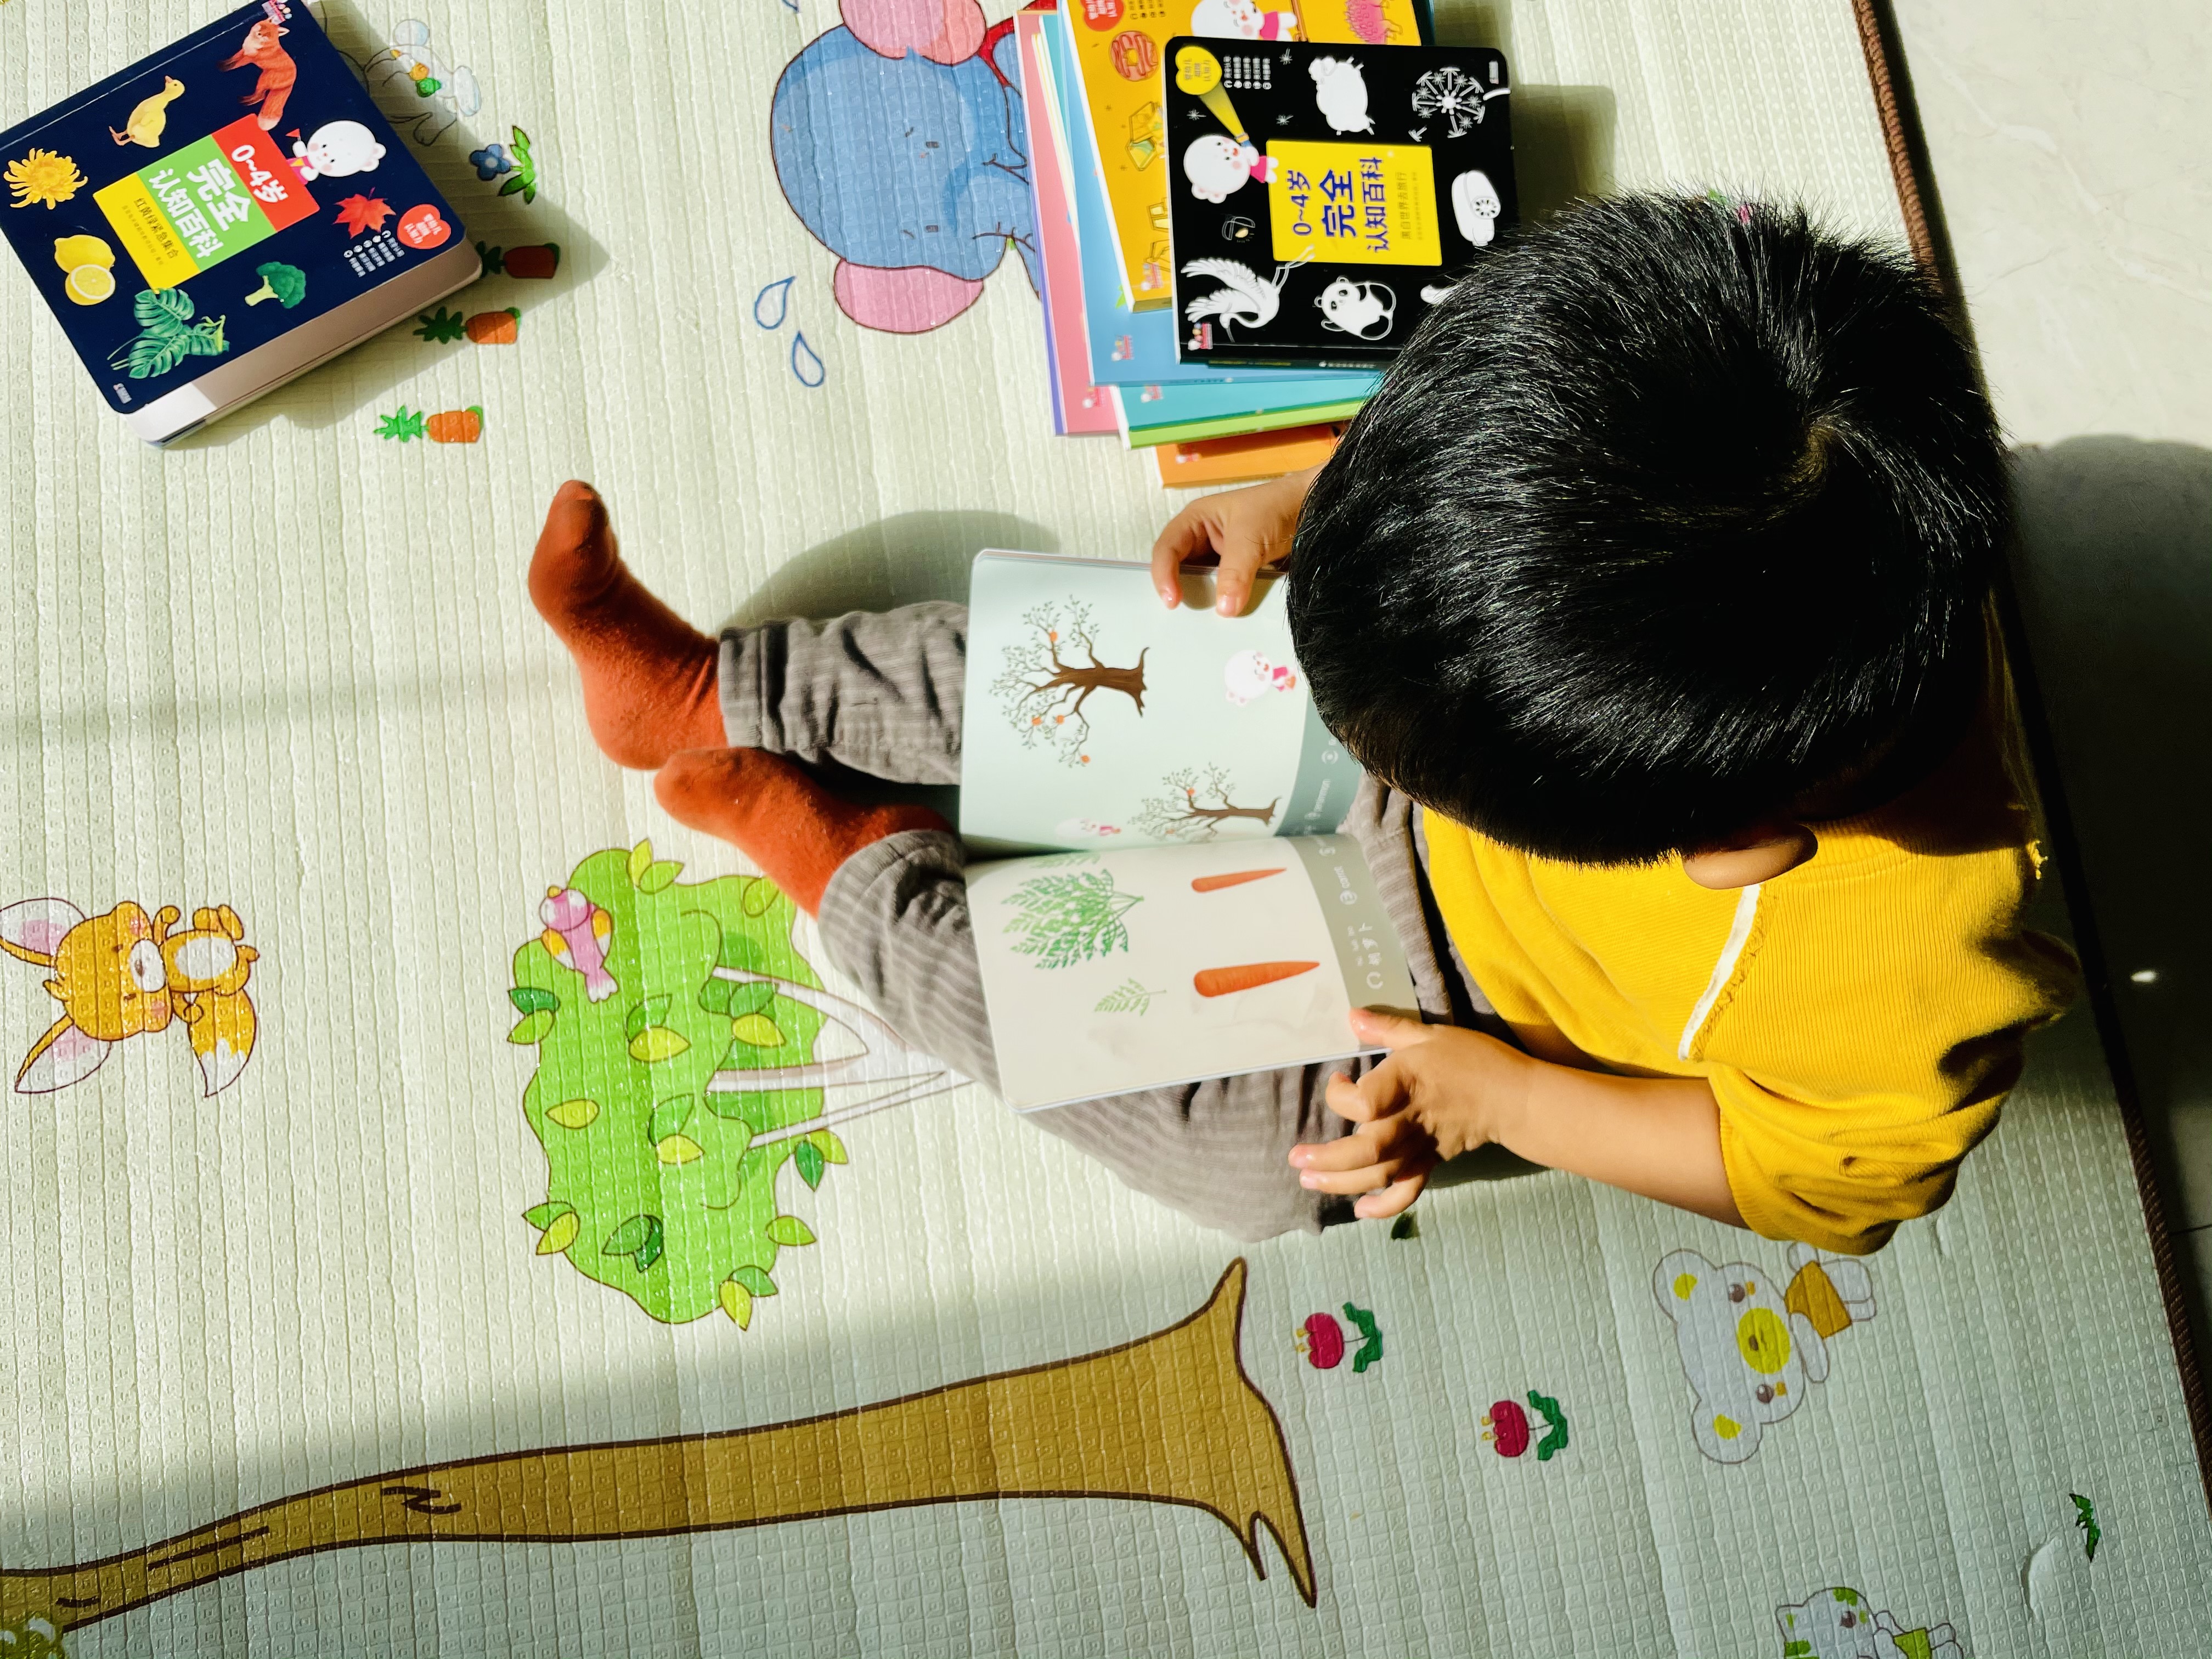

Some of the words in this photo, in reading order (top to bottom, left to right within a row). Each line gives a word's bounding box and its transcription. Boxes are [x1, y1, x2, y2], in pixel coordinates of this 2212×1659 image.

[186, 158, 251, 232] 完全
[232, 145, 289, 202] 0~4岁
[1286, 170, 1312, 236] 0~4岁
[1319, 169, 1357, 238] 完全
[1359, 157, 1390, 252] 认知百科
[1395, 171, 1410, 240] 黑白世界去旅行
[133, 198, 179, 259] 红黄绿紧急集合
[149, 168, 224, 258] 认知百科
